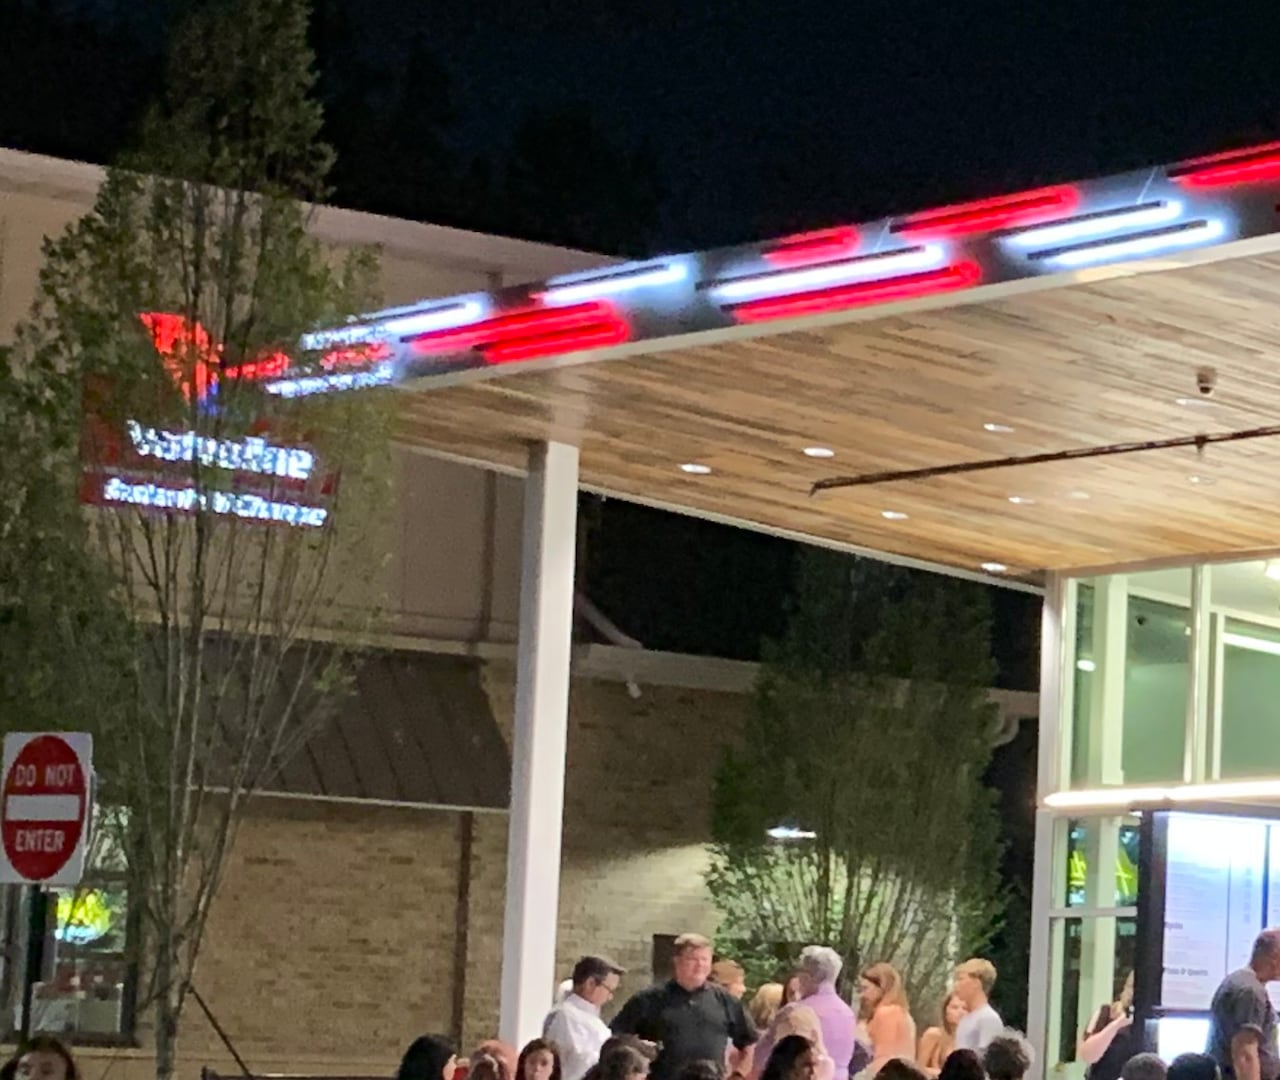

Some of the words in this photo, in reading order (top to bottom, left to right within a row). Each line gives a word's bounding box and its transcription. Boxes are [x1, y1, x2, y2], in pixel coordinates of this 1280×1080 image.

[15, 763, 37, 787] DO
[44, 762, 76, 788] NOT
[15, 828, 66, 854] ENTER
